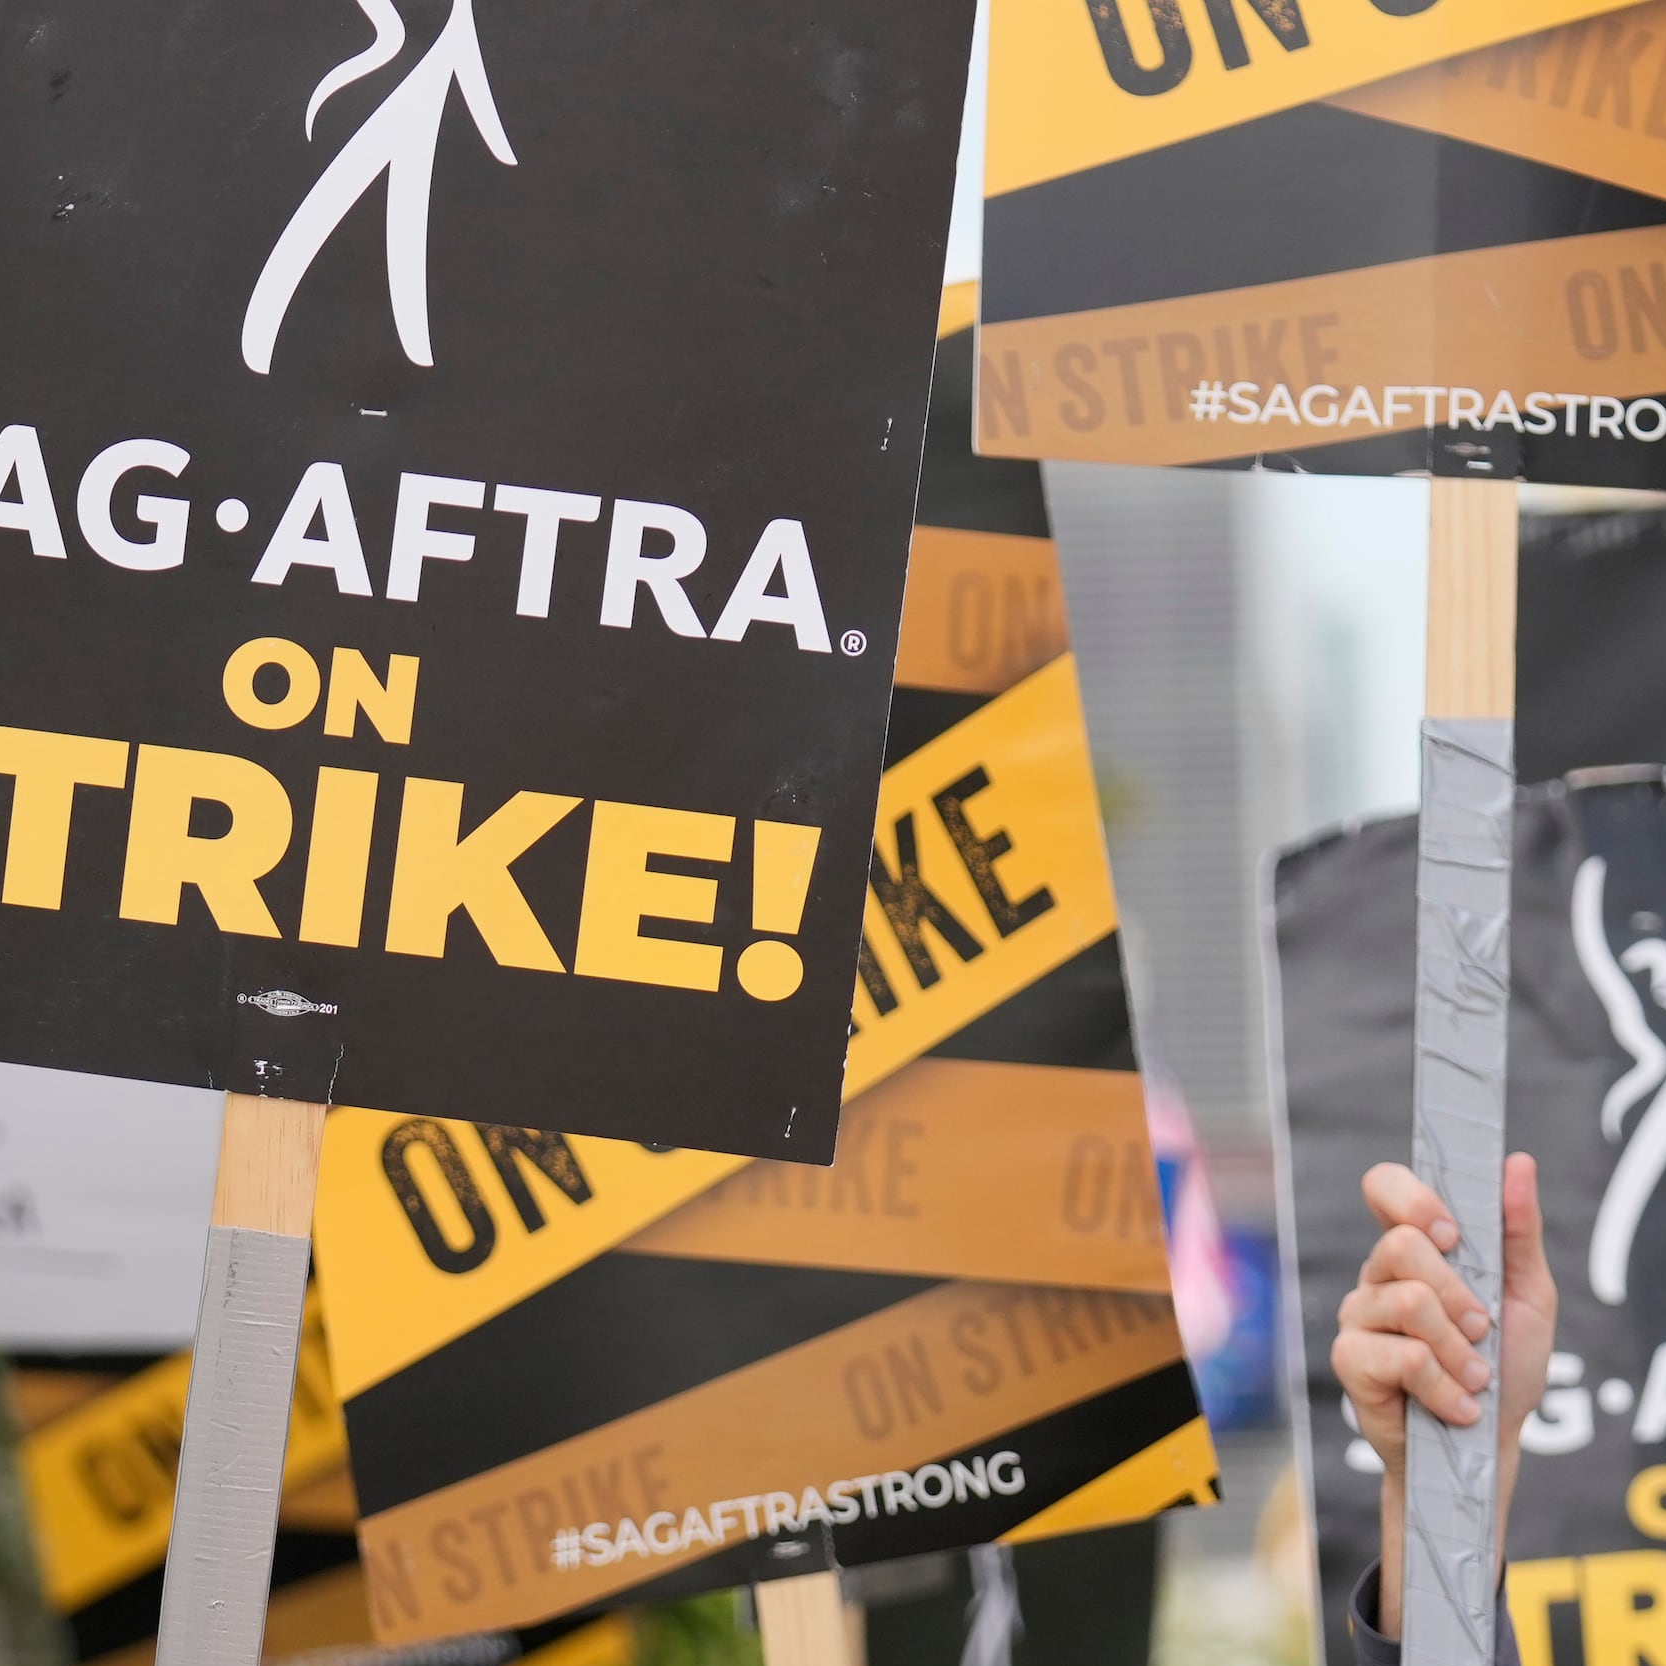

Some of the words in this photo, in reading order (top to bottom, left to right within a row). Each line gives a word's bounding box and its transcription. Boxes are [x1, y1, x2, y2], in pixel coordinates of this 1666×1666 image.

[1053, 312, 1341, 436] STRIKE
[222, 637, 419, 746] ON
[841, 1330, 945, 1442] ON
[429, 1442, 668, 1607] STRIKE
[550, 1449, 1026, 1573] #SAGAFTRASTRONG
